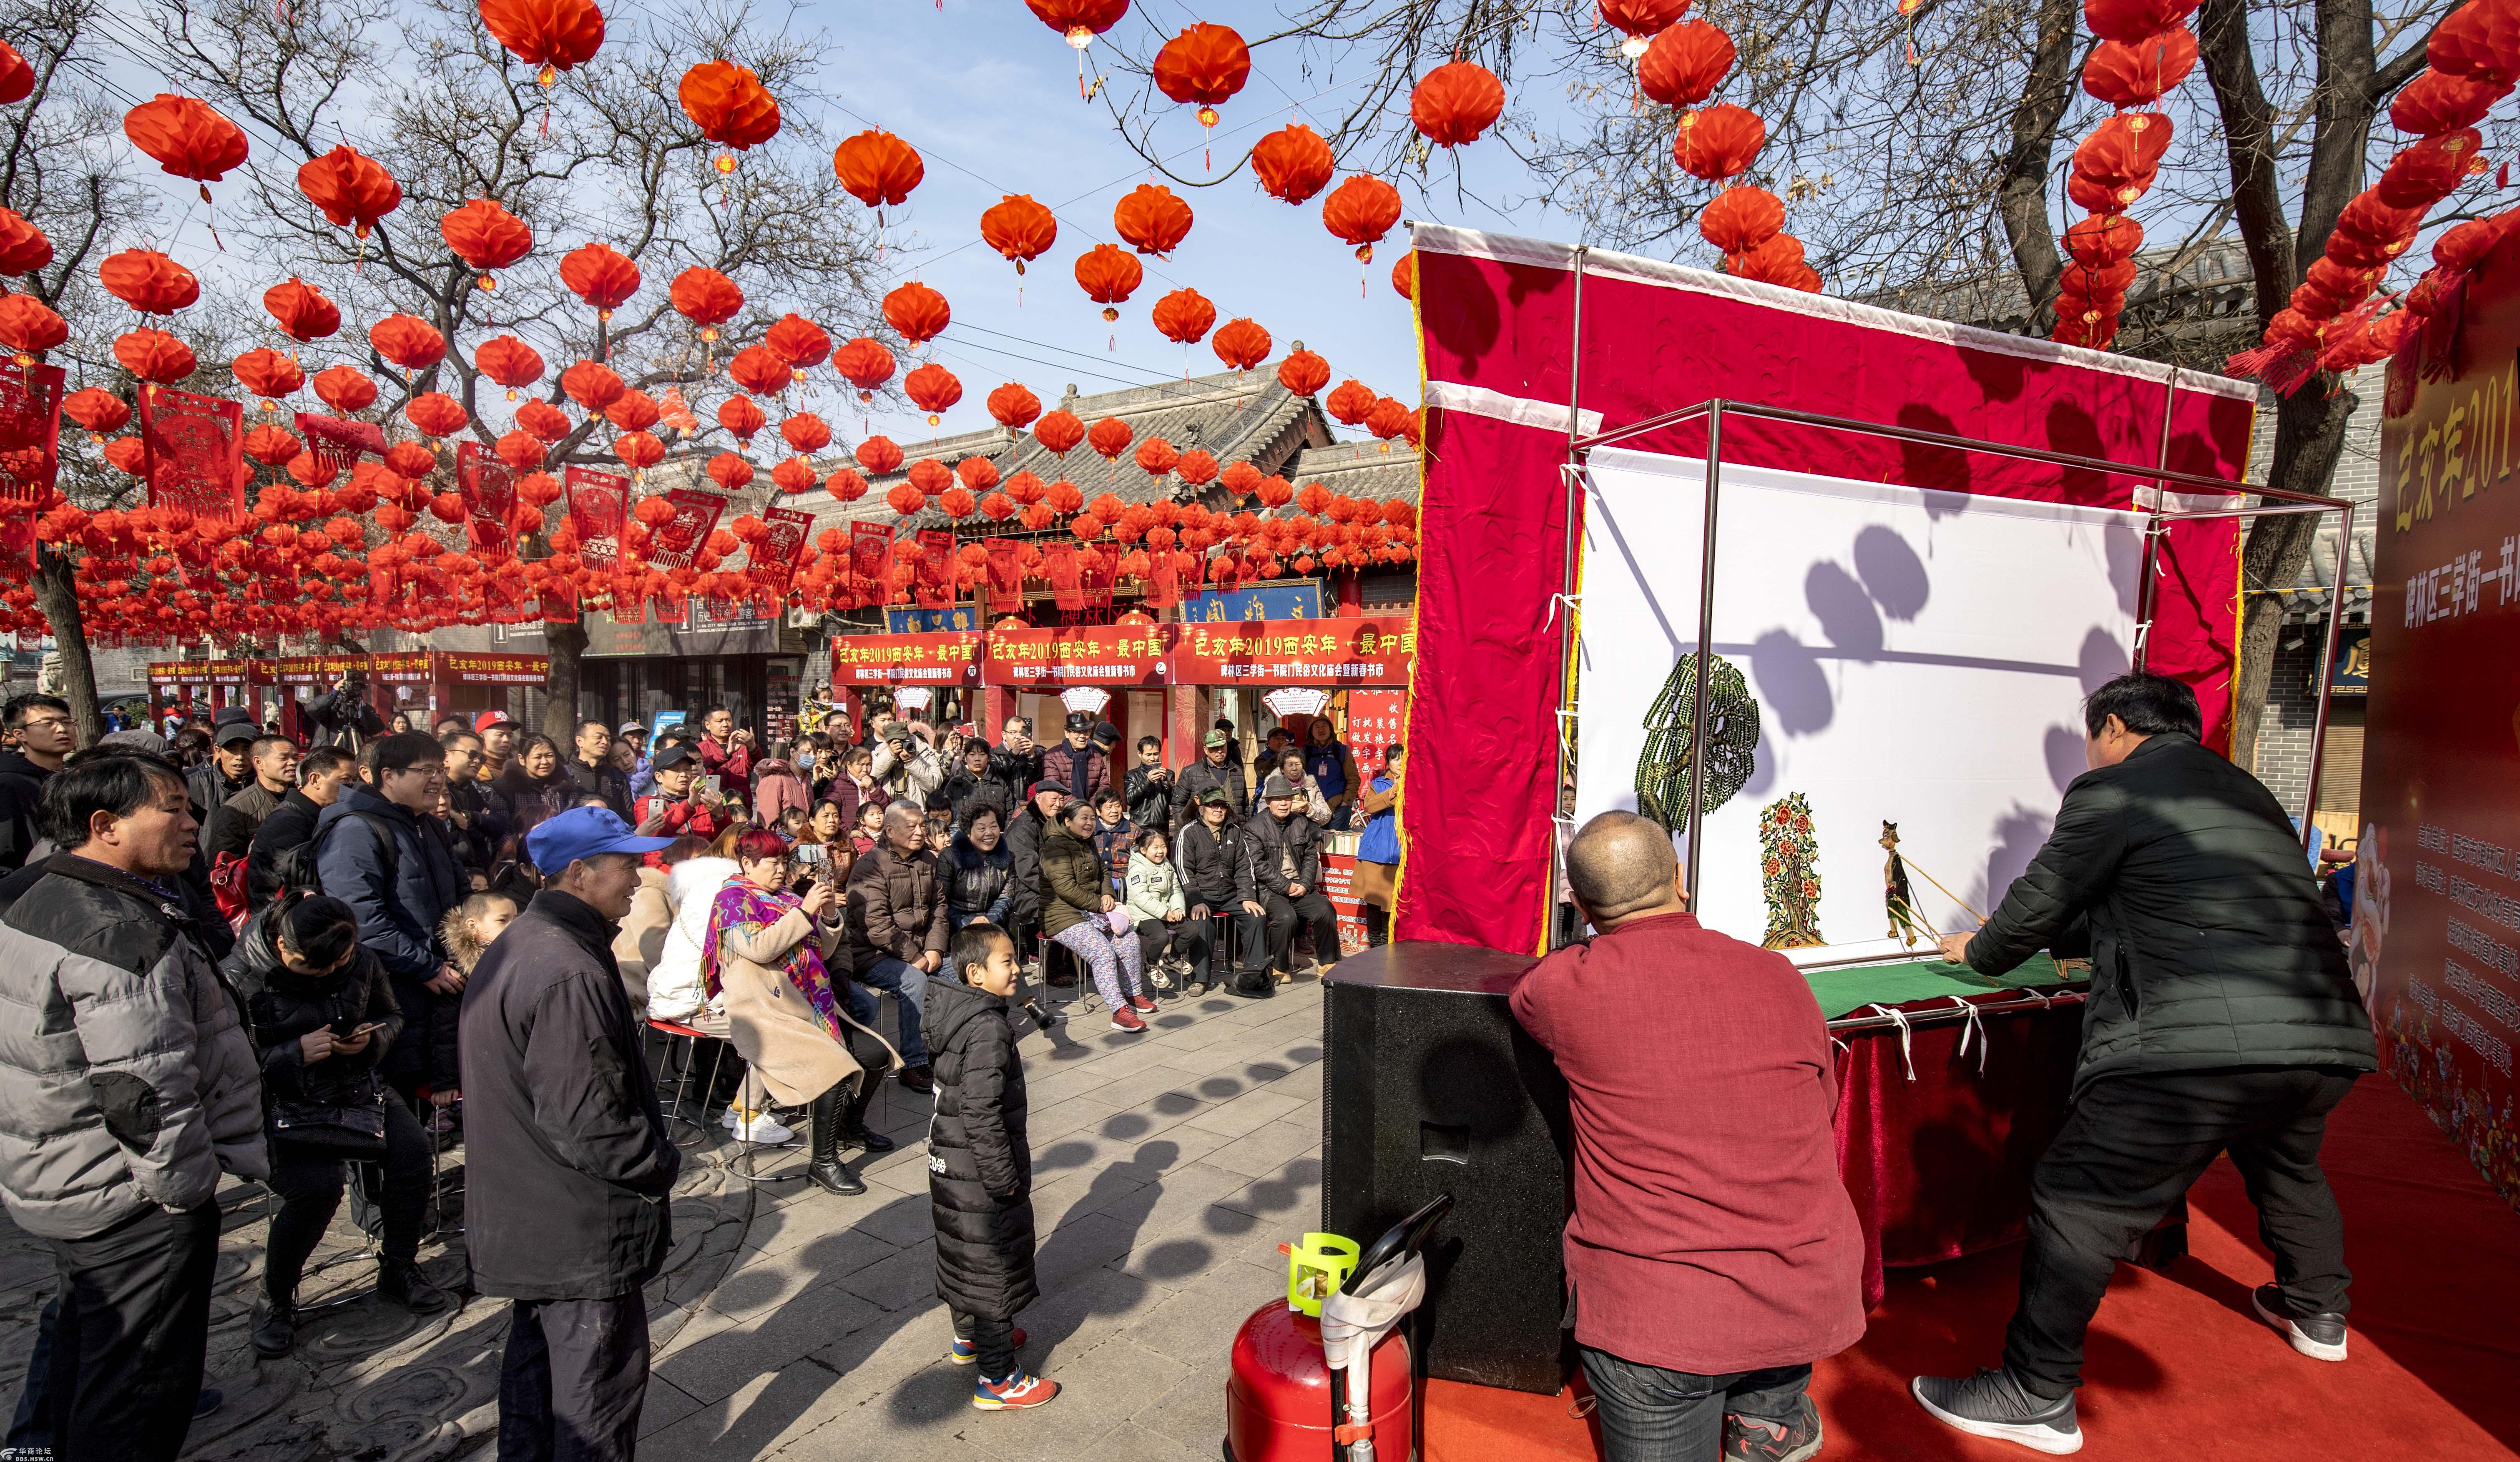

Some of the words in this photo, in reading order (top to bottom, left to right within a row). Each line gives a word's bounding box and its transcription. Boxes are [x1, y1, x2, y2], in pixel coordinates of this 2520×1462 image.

[1202, 111, 1214, 123] 福
[2132, 118, 2143, 128] 福
[358, 226, 367, 236] 福
[2396, 359, 2520, 532] 己亥年201
[969, 667, 975, 677] 丙
[1157, 664, 1164, 673] 乙
